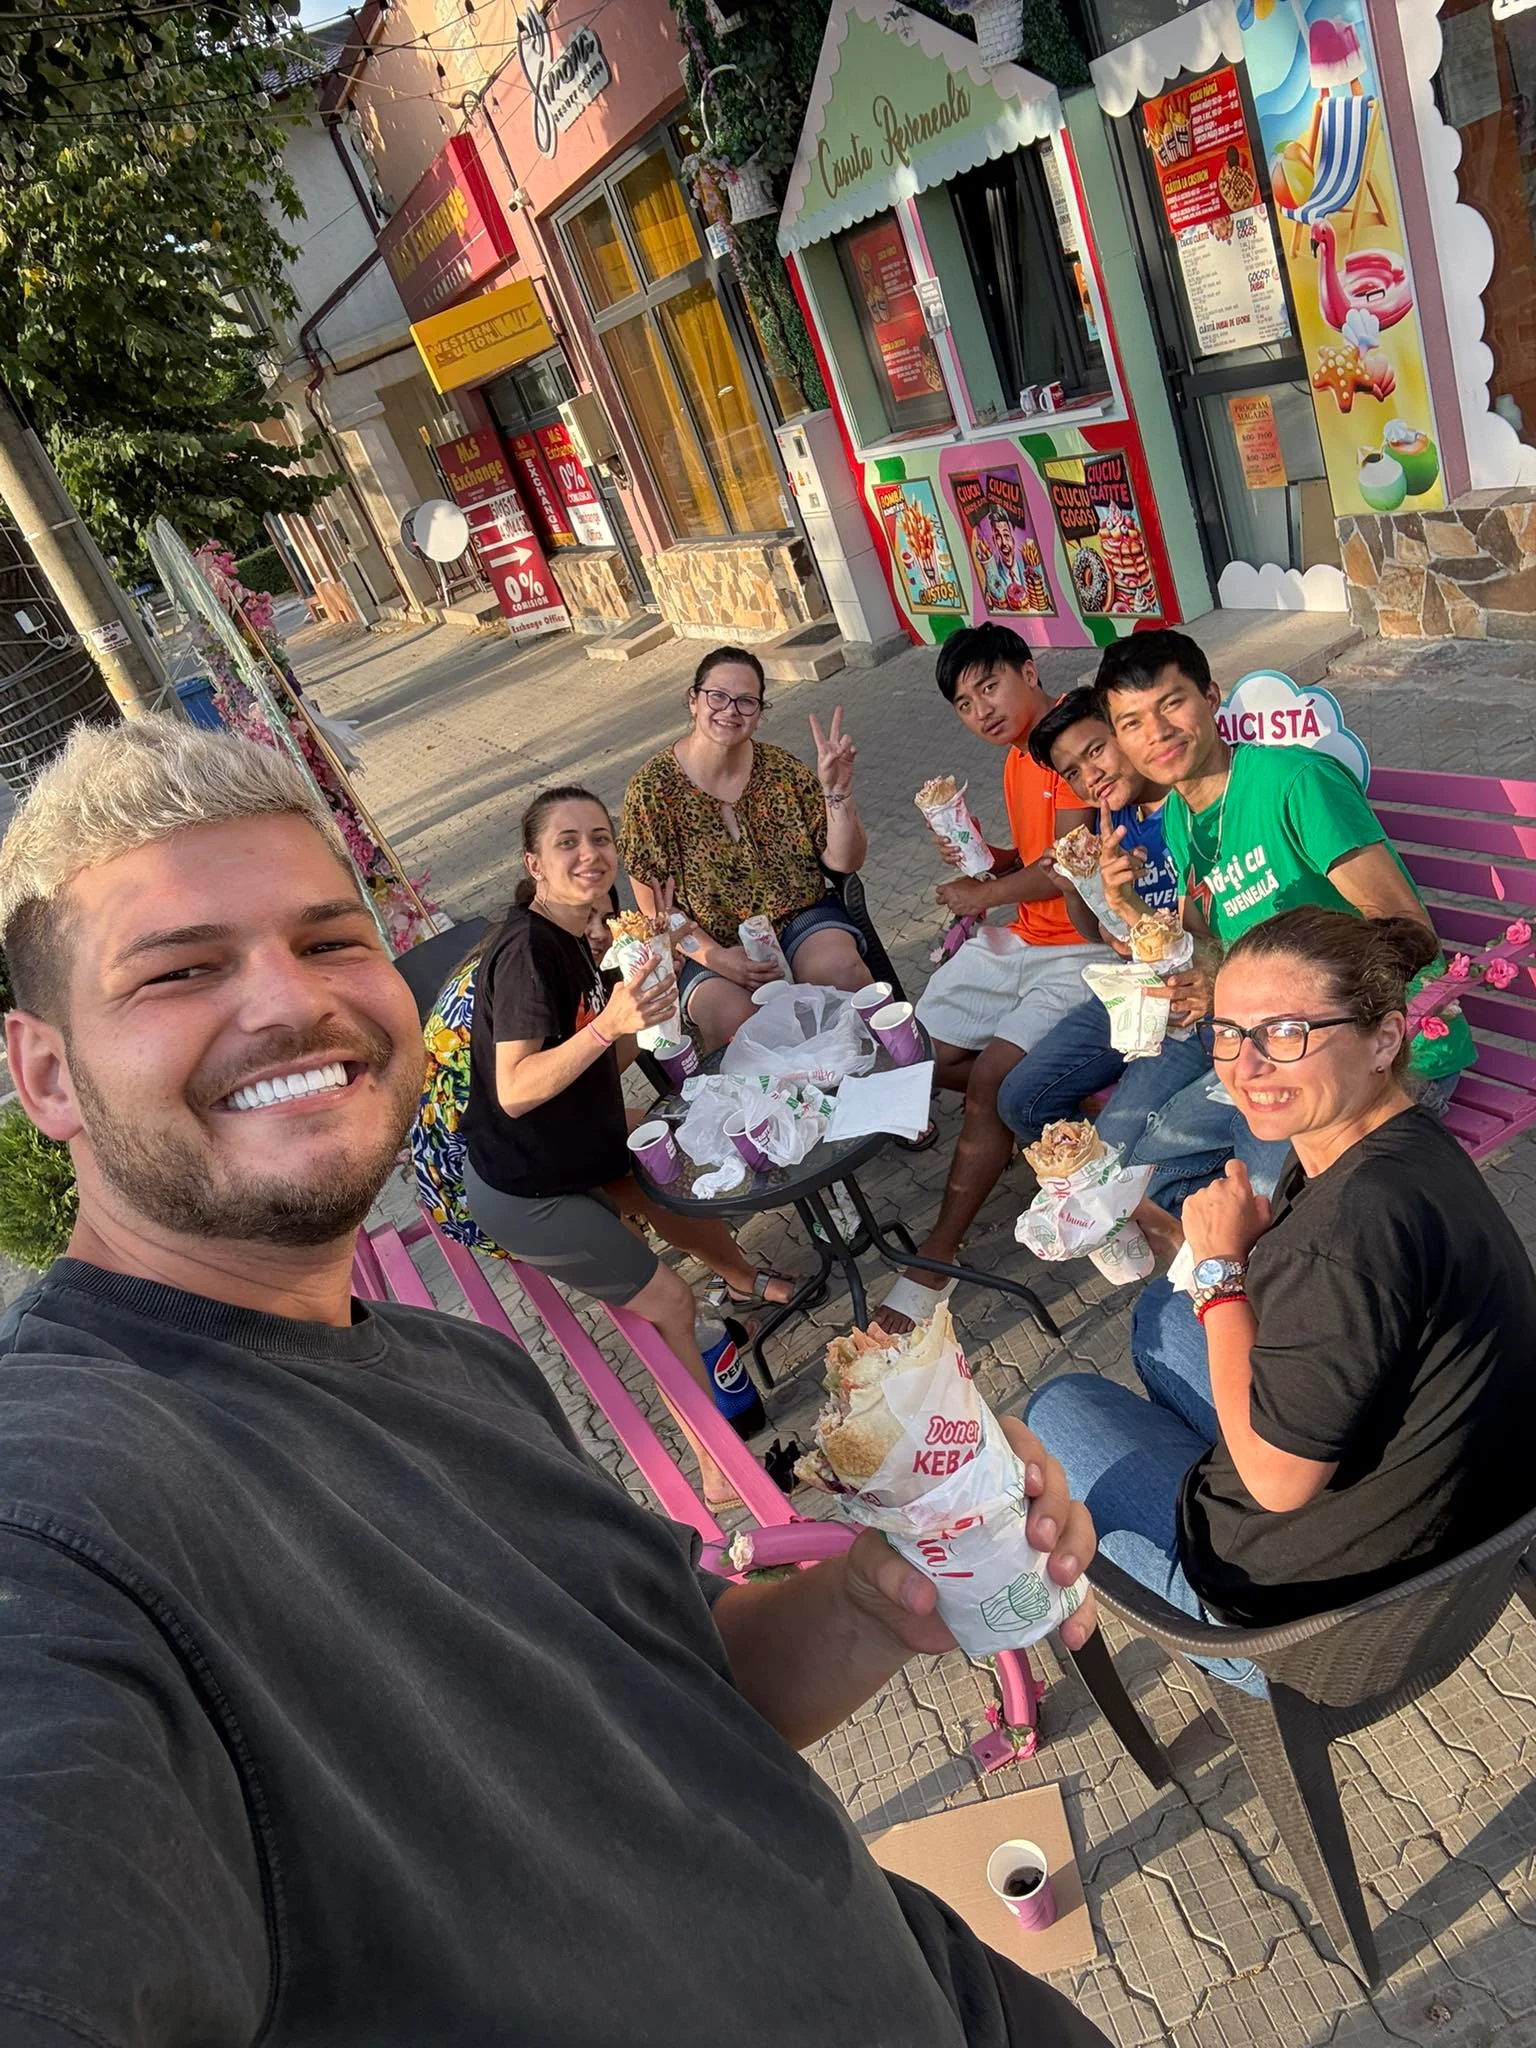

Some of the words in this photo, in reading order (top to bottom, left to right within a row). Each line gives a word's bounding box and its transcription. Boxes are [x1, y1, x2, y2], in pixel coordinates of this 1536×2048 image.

[413, 185, 470, 264] Exchange
[429, 322, 493, 355] WESTERN
[454, 334, 500, 360] UNION
[449, 459, 505, 493] Exchange
[558, 461, 586, 491] 0%
[1086, 458, 1121, 482] CIUCIU
[524, 457, 562, 534] EXCHANGE
[989, 477, 1019, 503] CIUCIU
[1052, 484, 1091, 507] CIUCIU
[504, 568, 545, 604] 0%
[511, 595, 550, 613] COMISION
[510, 620, 544, 634] Exchange
[543, 612, 566, 625] Office
[1216, 711, 1265, 742] AICI
[1245, 844, 1267, 873] cu
[1222, 868, 1280, 919] EVENEALĂ
